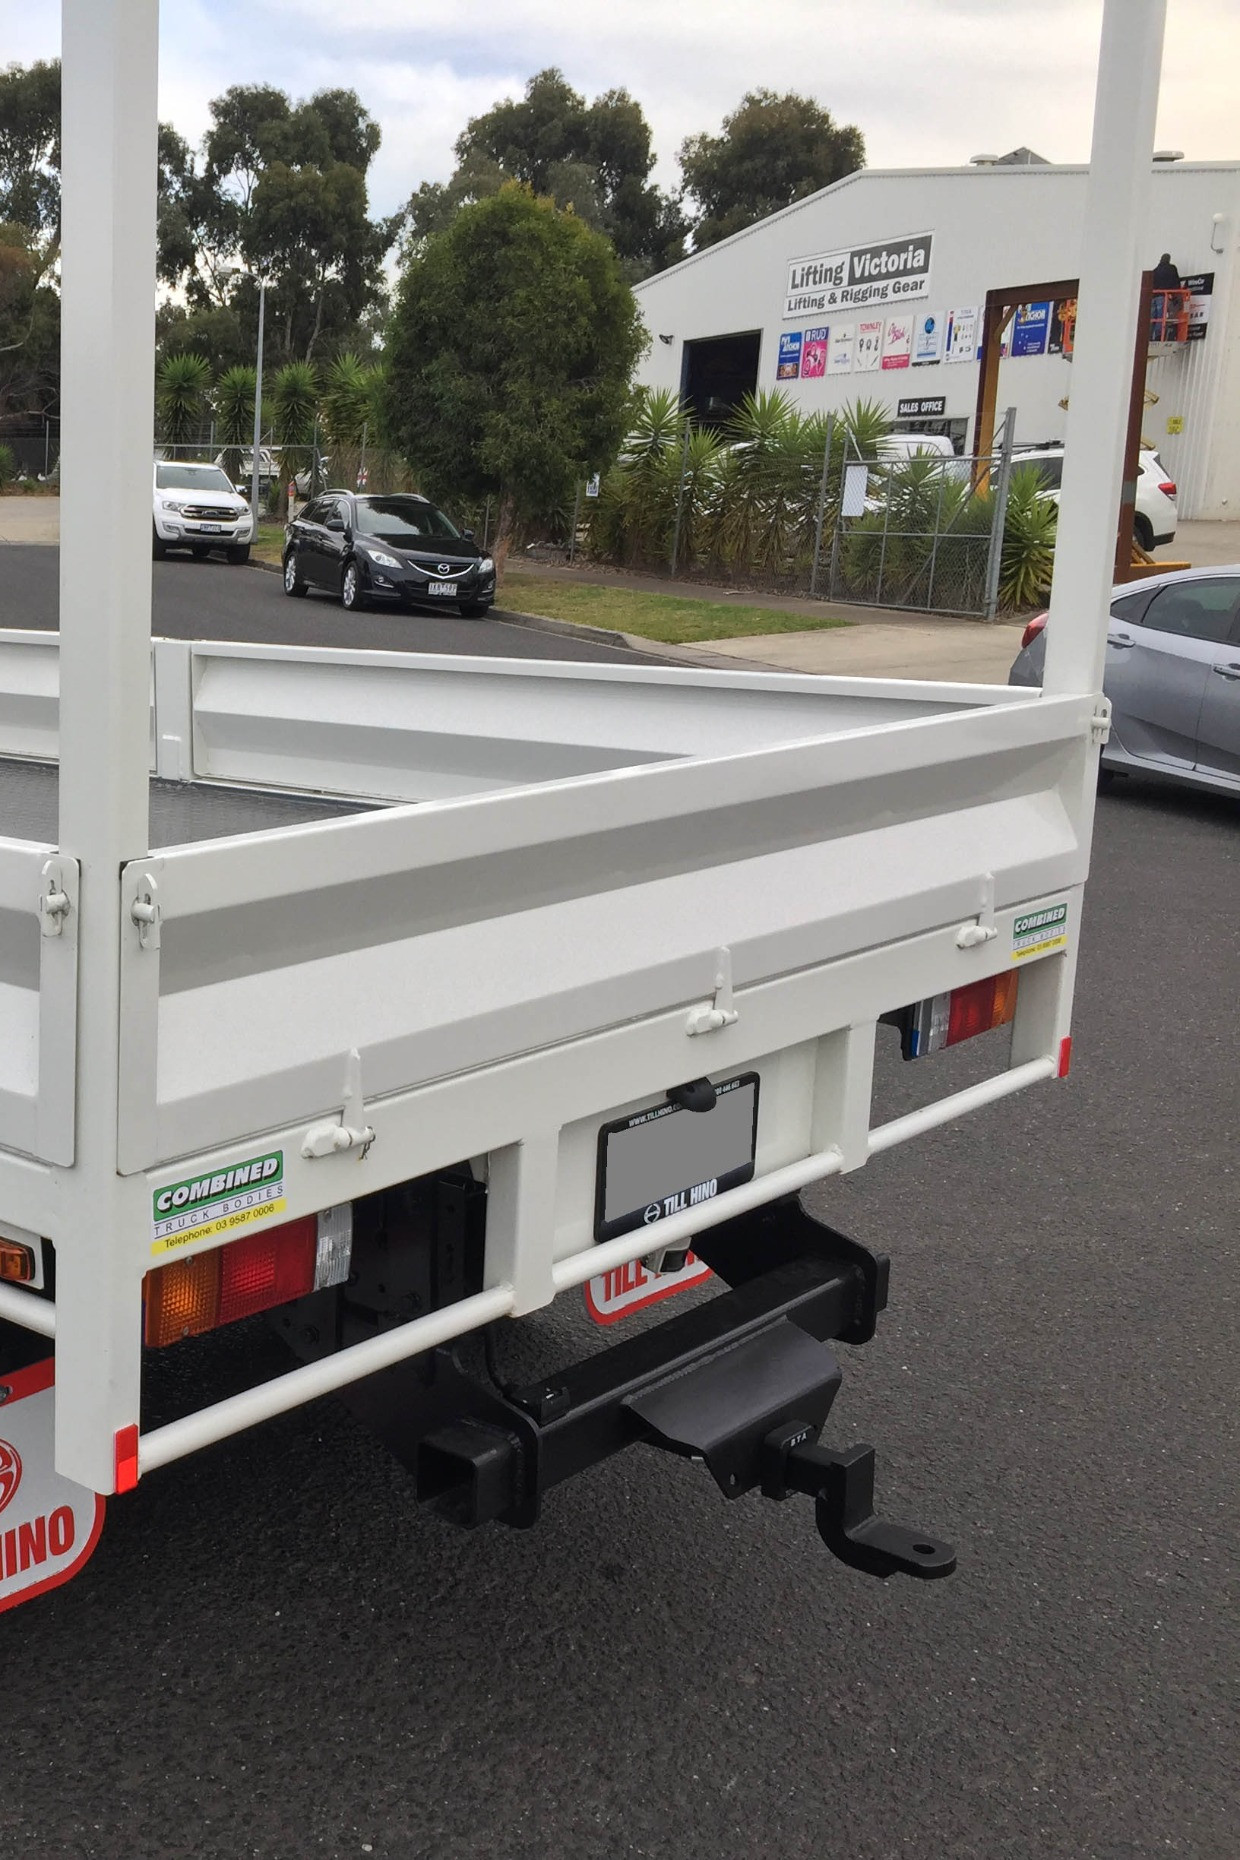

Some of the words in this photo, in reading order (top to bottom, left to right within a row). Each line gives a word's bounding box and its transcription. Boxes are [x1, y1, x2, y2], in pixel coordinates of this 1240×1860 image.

[791, 261, 845, 290] Lifting
[853, 245, 926, 279] Victoria
[787, 295, 825, 311] Lifting
[828, 292, 837, 304] &
[840, 283, 889, 303] Rigging
[892, 279, 925, 294] Gear
[811, 329, 826, 340] RUD
[900, 402, 919, 413] SALES
[921, 400, 943, 412] OFFICE
[1015, 907, 1065, 933] COMBINED
[157, 1158, 279, 1212] COMBINED
[664, 1193, 687, 1215] TILL
[690, 1178, 718, 1206] HINO
[154, 1210, 210, 1236] TRUCK
[223, 1185, 283, 1212] BODIES
[164, 1226, 213, 1248] Telephone:
[216, 1221, 227, 1231] 03
[230, 1211, 251, 1226] 9587
[253, 1203, 275, 1217] 0006
[601, 1258, 648, 1303] TILL
